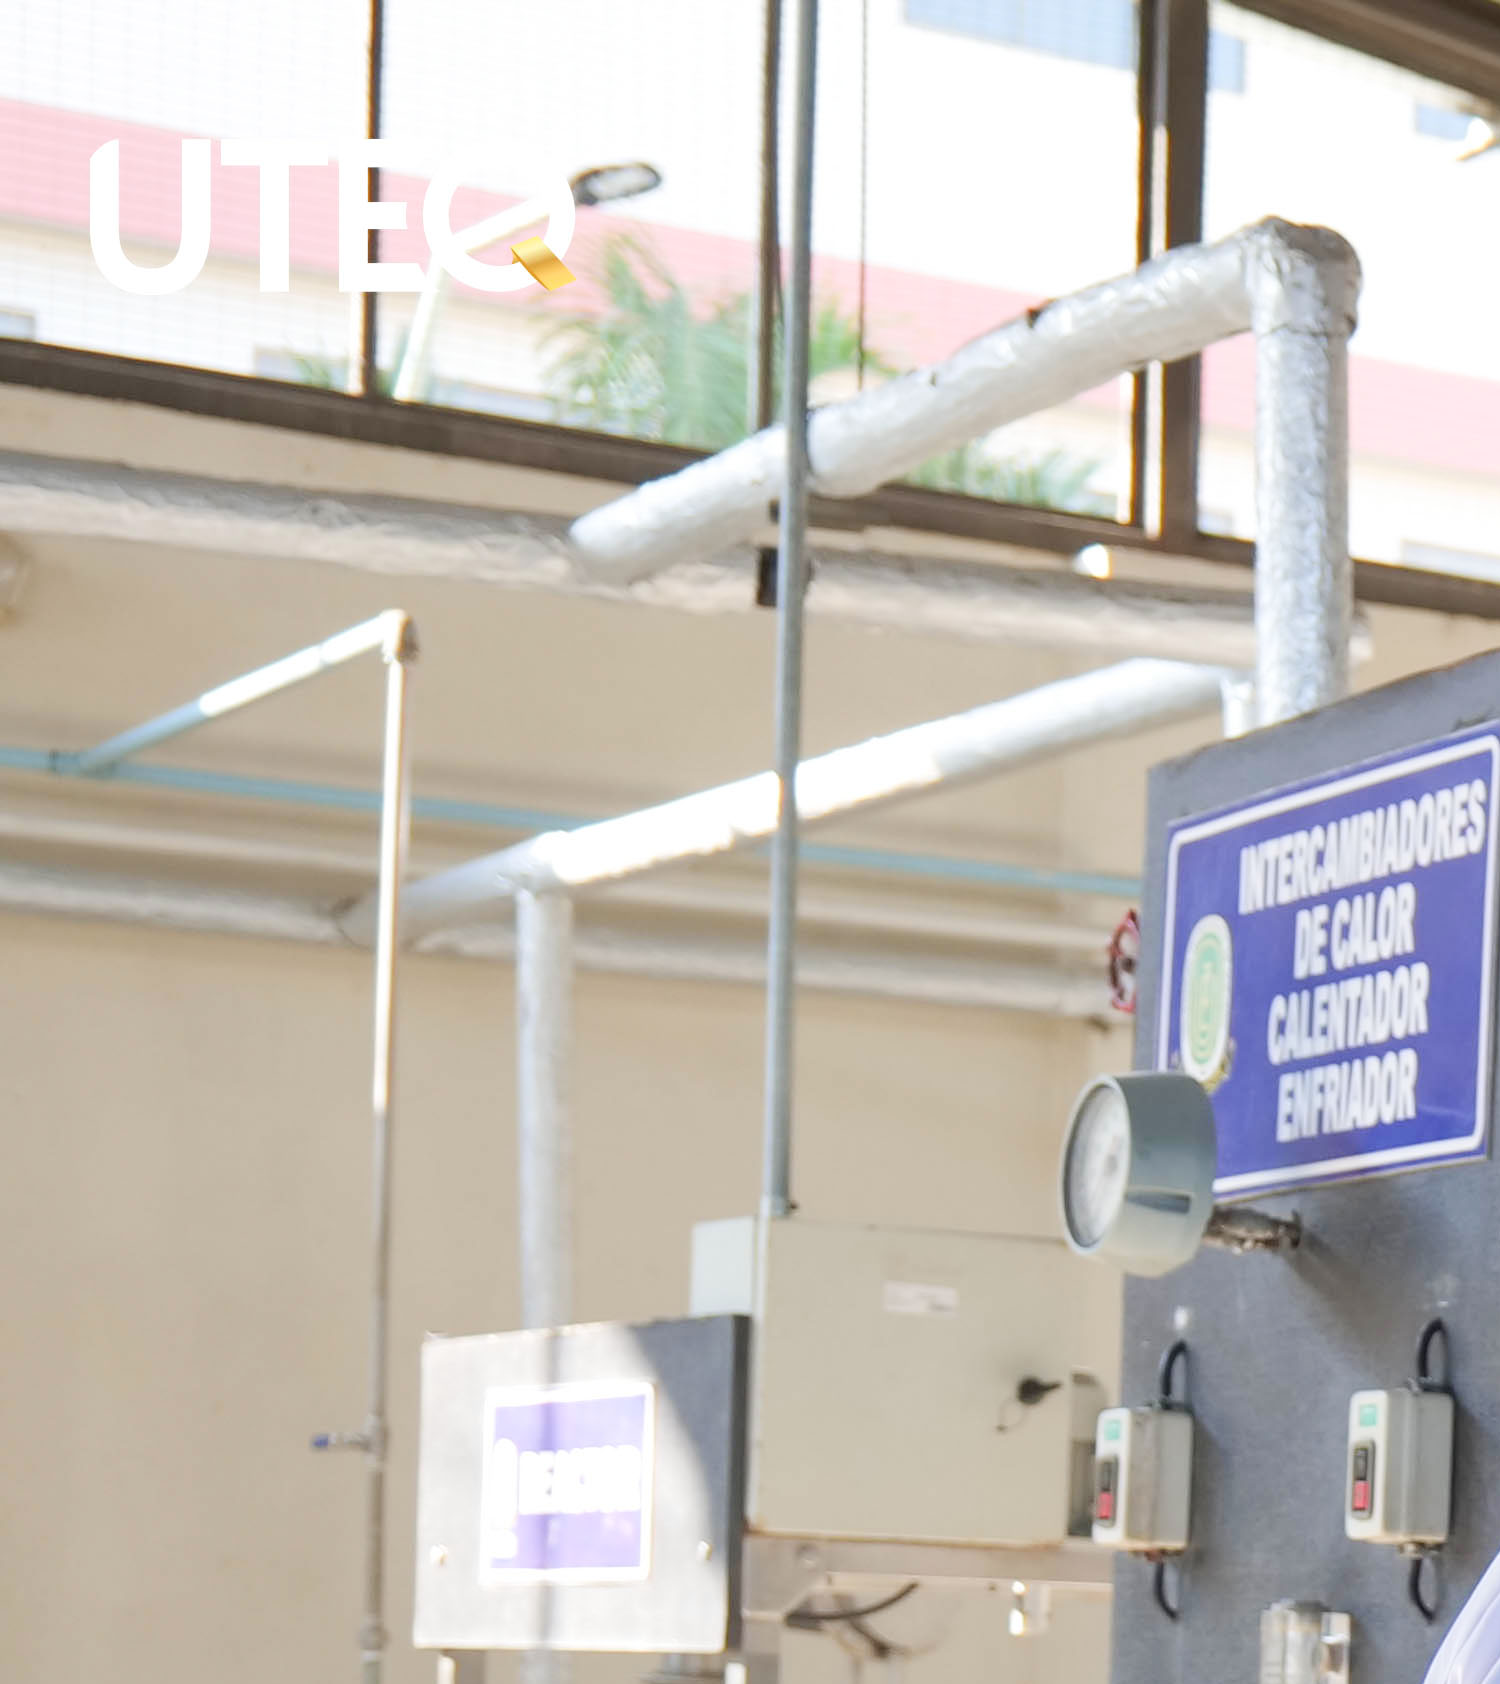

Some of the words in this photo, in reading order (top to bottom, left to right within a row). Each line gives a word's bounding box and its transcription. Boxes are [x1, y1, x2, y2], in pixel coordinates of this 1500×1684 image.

[1238, 779, 1487, 915] INTERCAMBIADORES
[1294, 909, 1329, 979] DE
[1331, 882, 1417, 971] CALOR
[1267, 962, 1430, 1066] CALENTADOR
[1276, 1048, 1418, 1143] ENFRIADOR
